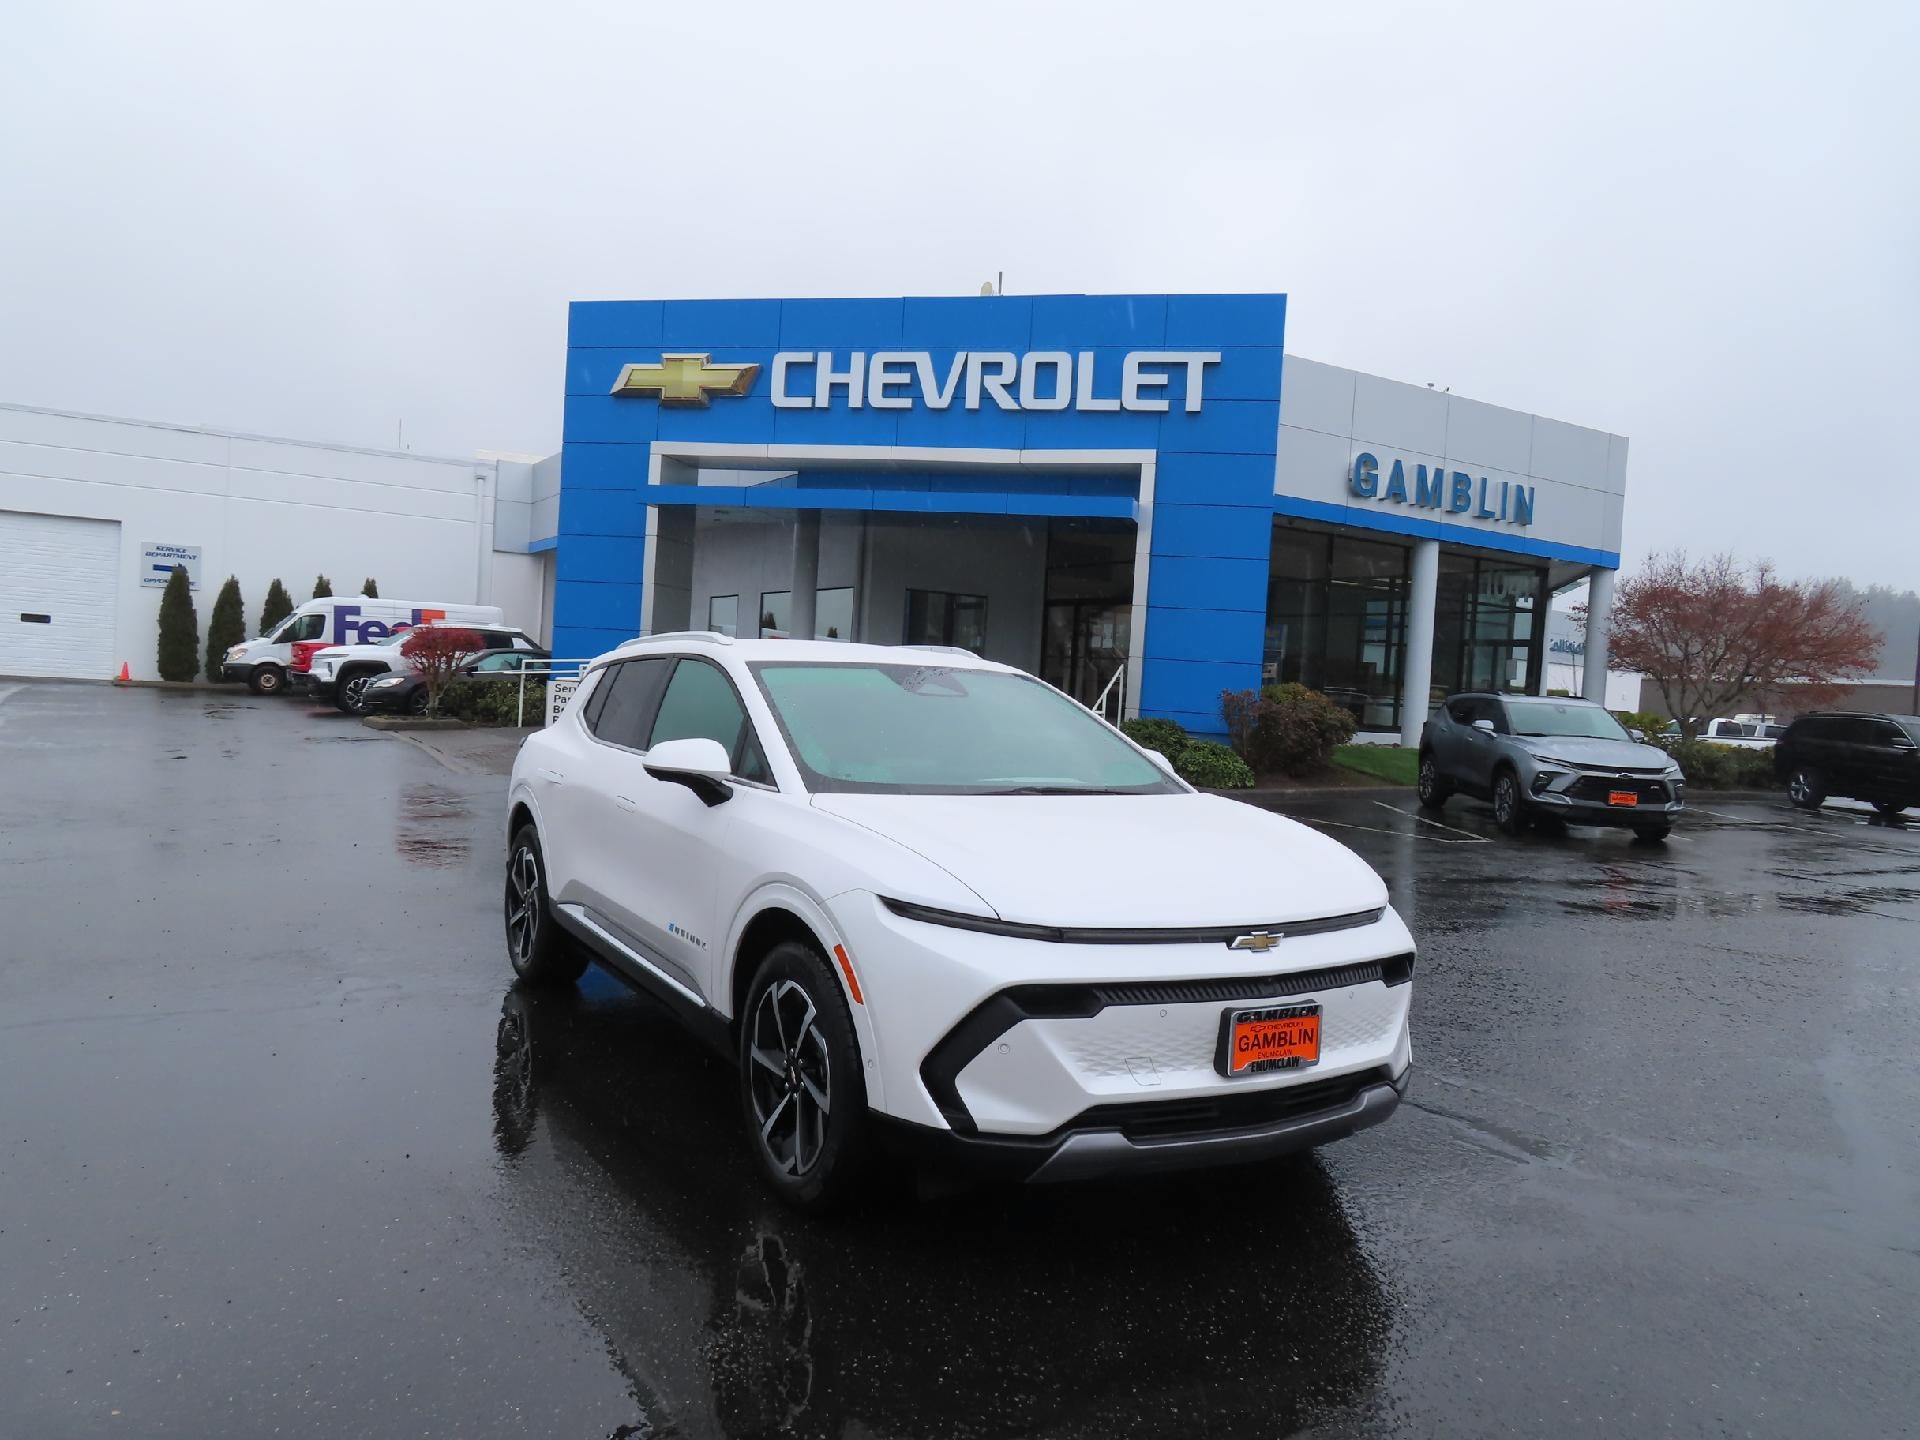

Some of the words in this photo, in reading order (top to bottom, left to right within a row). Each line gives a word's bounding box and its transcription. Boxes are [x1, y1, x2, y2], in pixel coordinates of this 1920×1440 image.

[771, 351, 1221, 412] CHEVROLET
[1351, 452, 1535, 525] GAMBLIN
[1238, 1028, 1314, 1052] GAMBLIN
[1250, 1056, 1300, 1072] ENUMCLAW
[1258, 1049, 1292, 1059] ENUMCLAW
